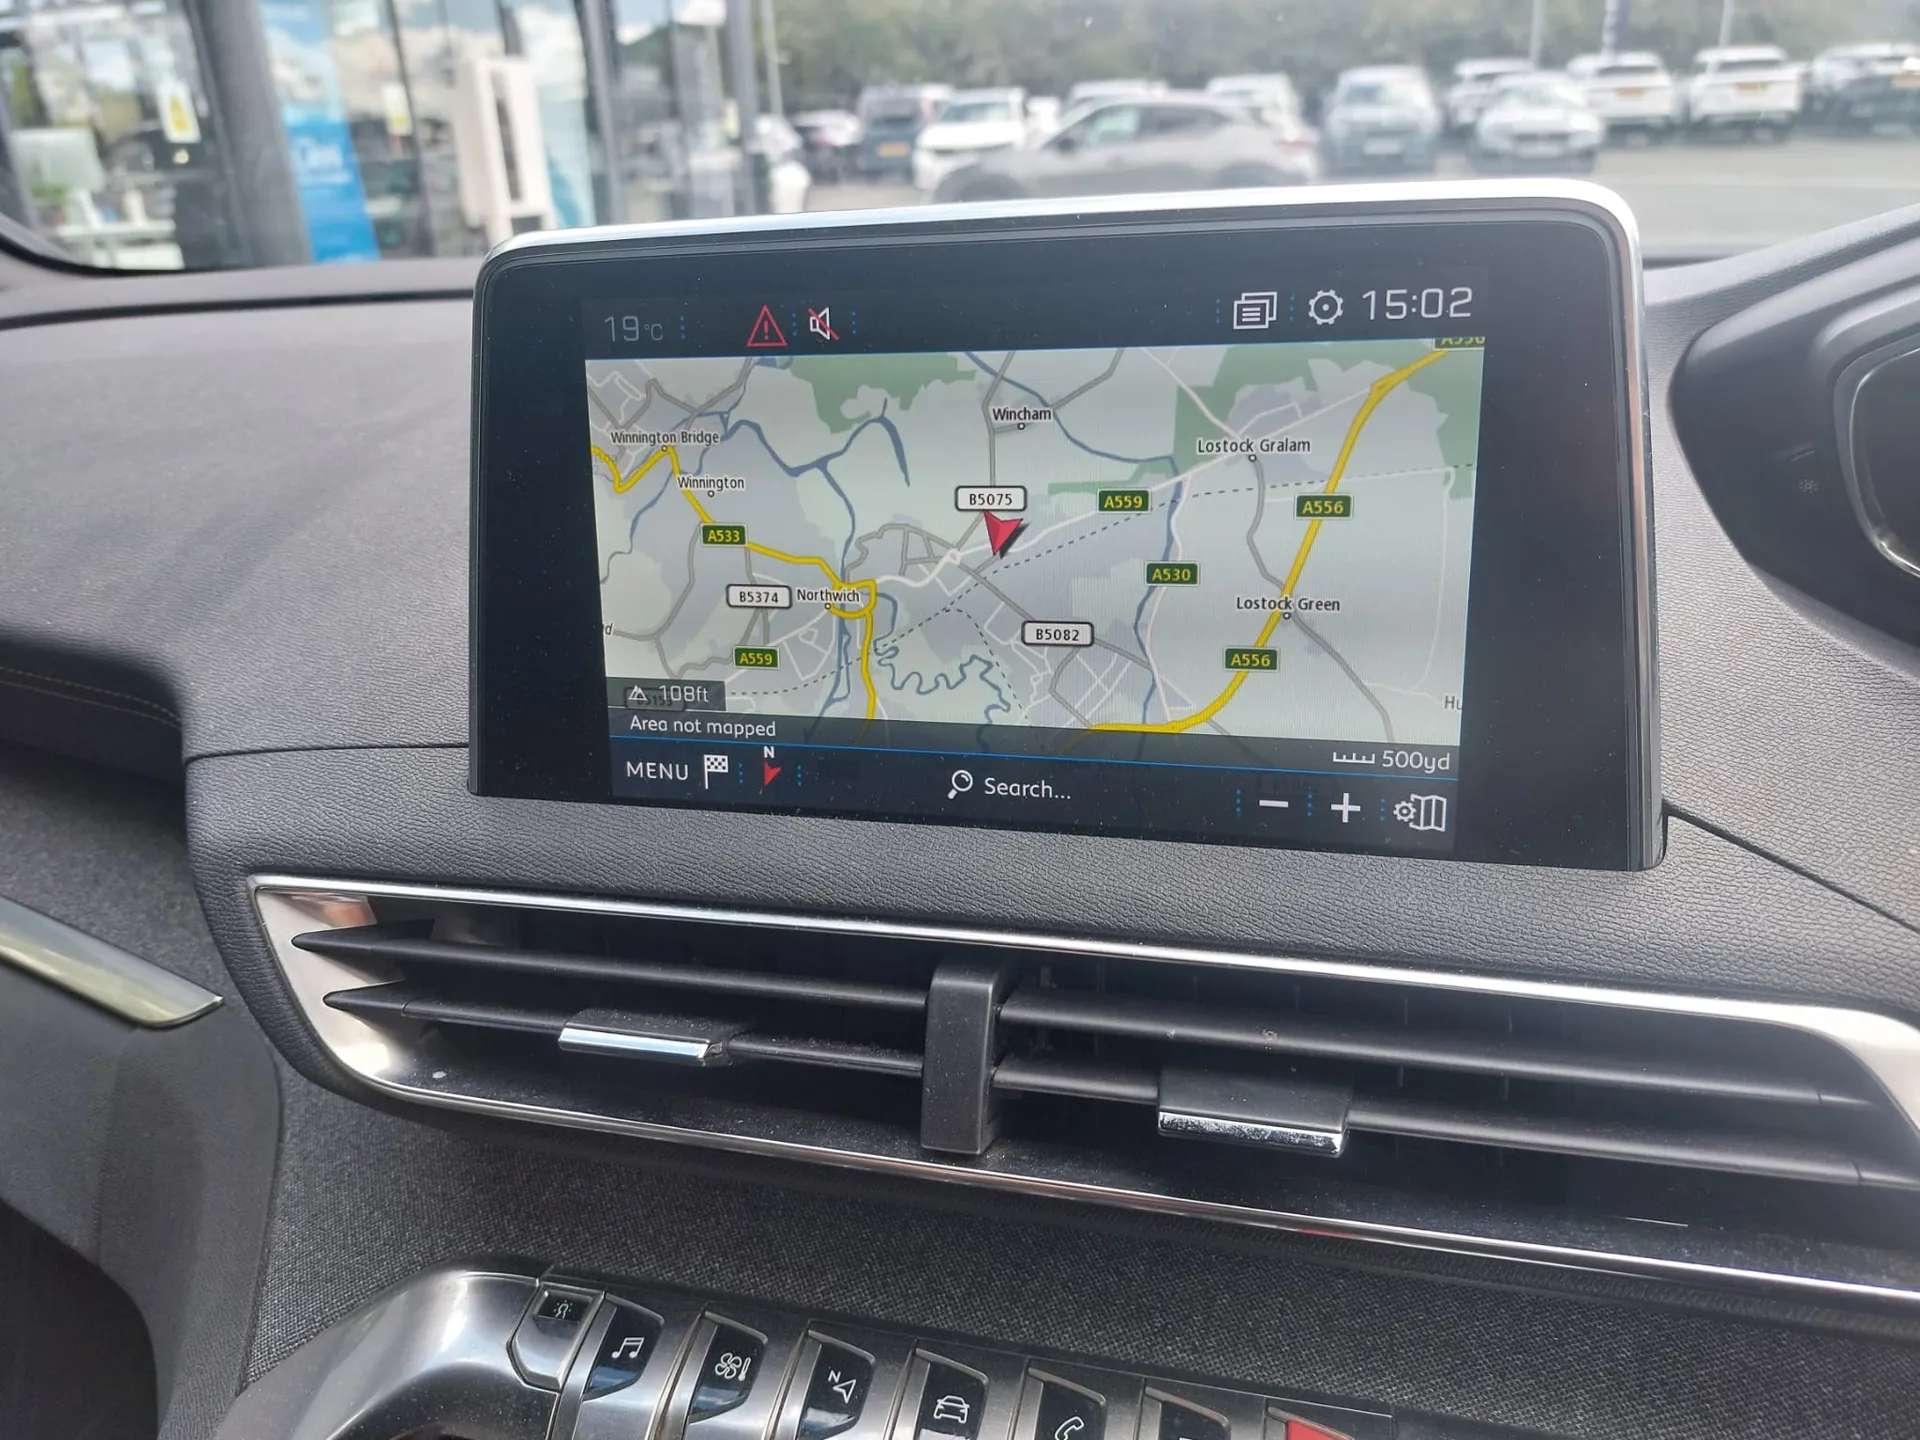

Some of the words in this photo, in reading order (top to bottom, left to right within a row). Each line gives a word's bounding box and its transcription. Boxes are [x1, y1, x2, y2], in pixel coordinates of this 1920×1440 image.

[1362, 287, 1472, 320] 15:02
[992, 406, 1052, 421] Wincham
[610, 430, 677, 446] Winnington
[681, 430, 720, 446] Bridge
[1198, 437, 1254, 453] Lostock
[1260, 437, 1311, 453] Gralam
[677, 473, 745, 491] Winnington
[969, 493, 1013, 506] B5075
[1104, 495, 1143, 508] A559
[1302, 500, 1344, 514] A556
[707, 529, 740, 543] A533
[1152, 568, 1191, 581] A530
[739, 591, 779, 604] B5374
[797, 588, 860, 602] Northwich
[1237, 596, 1292, 610] Lostock
[1298, 597, 1341, 611] Green
[1035, 628, 1080, 642] B5082
[740, 652, 773, 665] A559
[1231, 653, 1271, 667] A556
[659, 685, 709, 703] 108ft
[630, 714, 668, 731] Area
[673, 719, 702, 733] not
[706, 720, 776, 739] mapped
[763, 745, 775, 759] N
[1382, 750, 1450, 774] 500yd
[626, 761, 689, 781] MENU
[984, 777, 1071, 799] Search...
